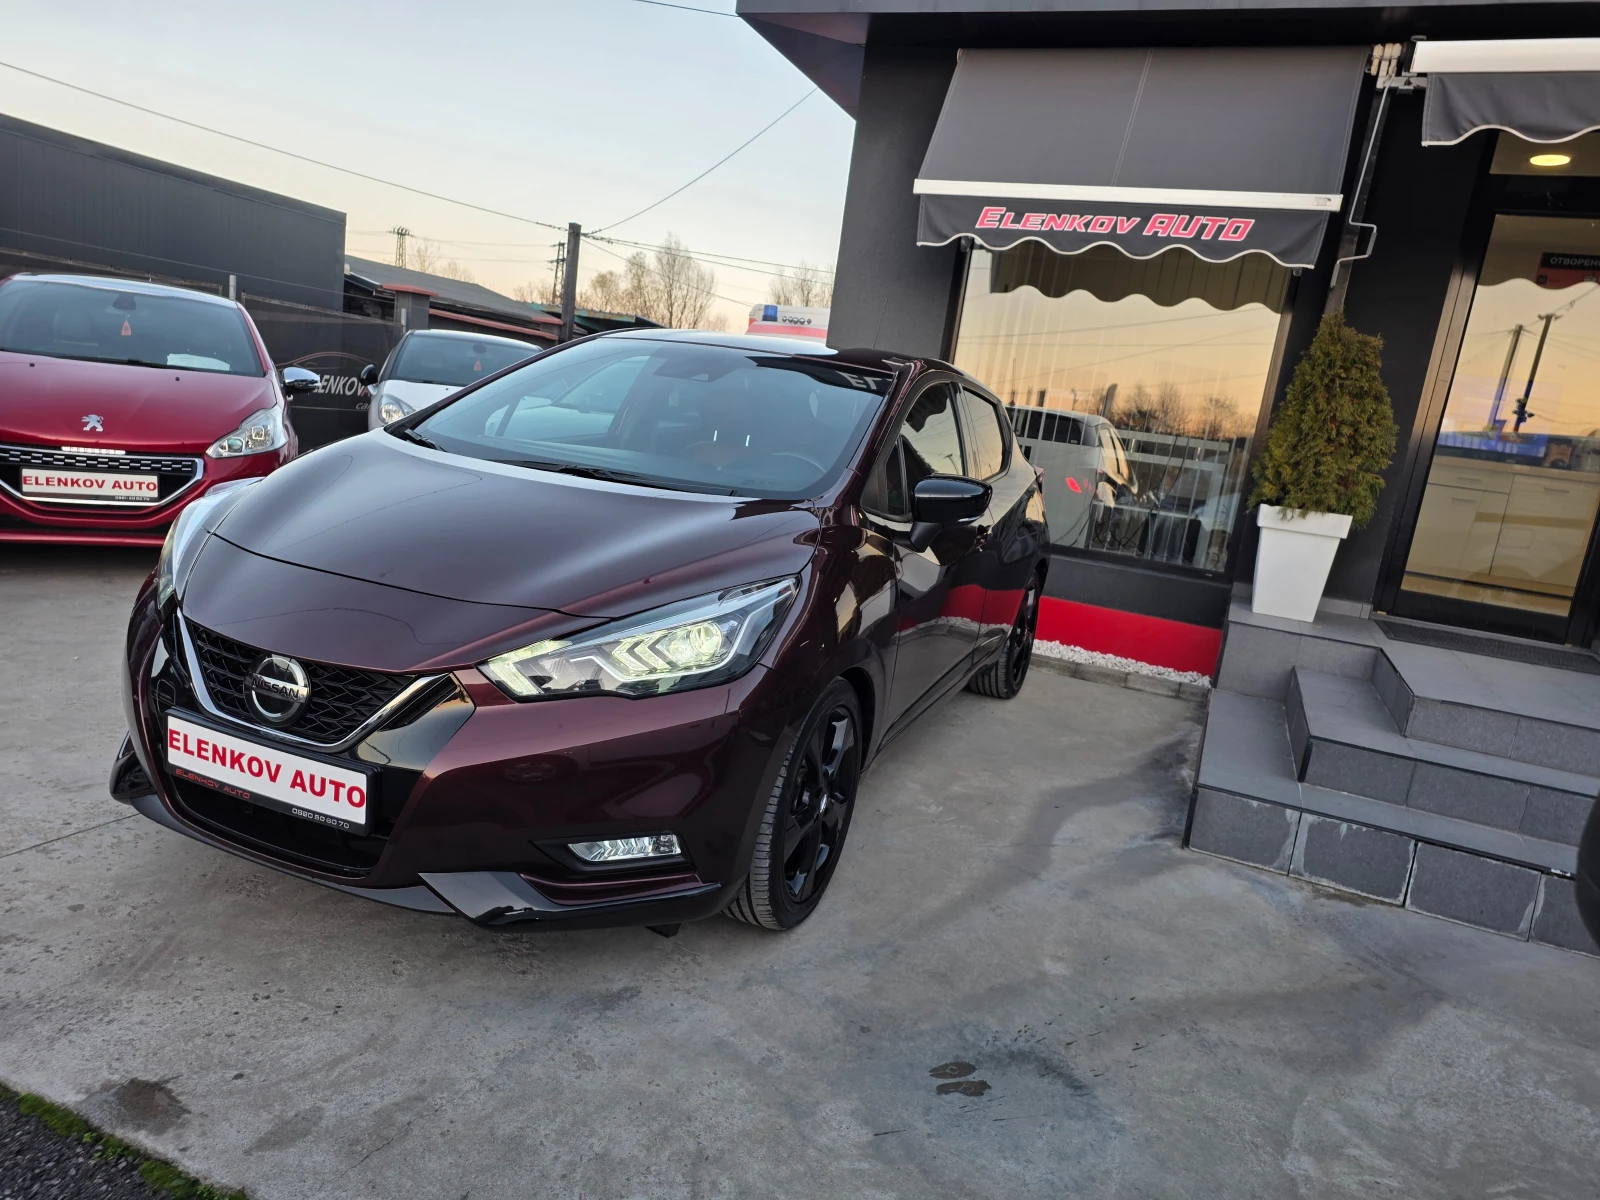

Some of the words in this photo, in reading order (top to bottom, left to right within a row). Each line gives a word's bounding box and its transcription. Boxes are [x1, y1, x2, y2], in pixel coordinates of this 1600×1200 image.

[975, 206, 1141, 235] ELENKOV
[1142, 213, 1255, 242] AUTO
[22, 475, 106, 489] ELENKOV
[111, 480, 157, 492] AUTO
[251, 676, 300, 700] NISSAN
[168, 728, 282, 783] ELENKOV
[290, 769, 366, 808] AUTO
[175, 768, 221, 789] ELENKOV
[223, 785, 251, 800] AUTO
[338, 820, 350, 829] 70
